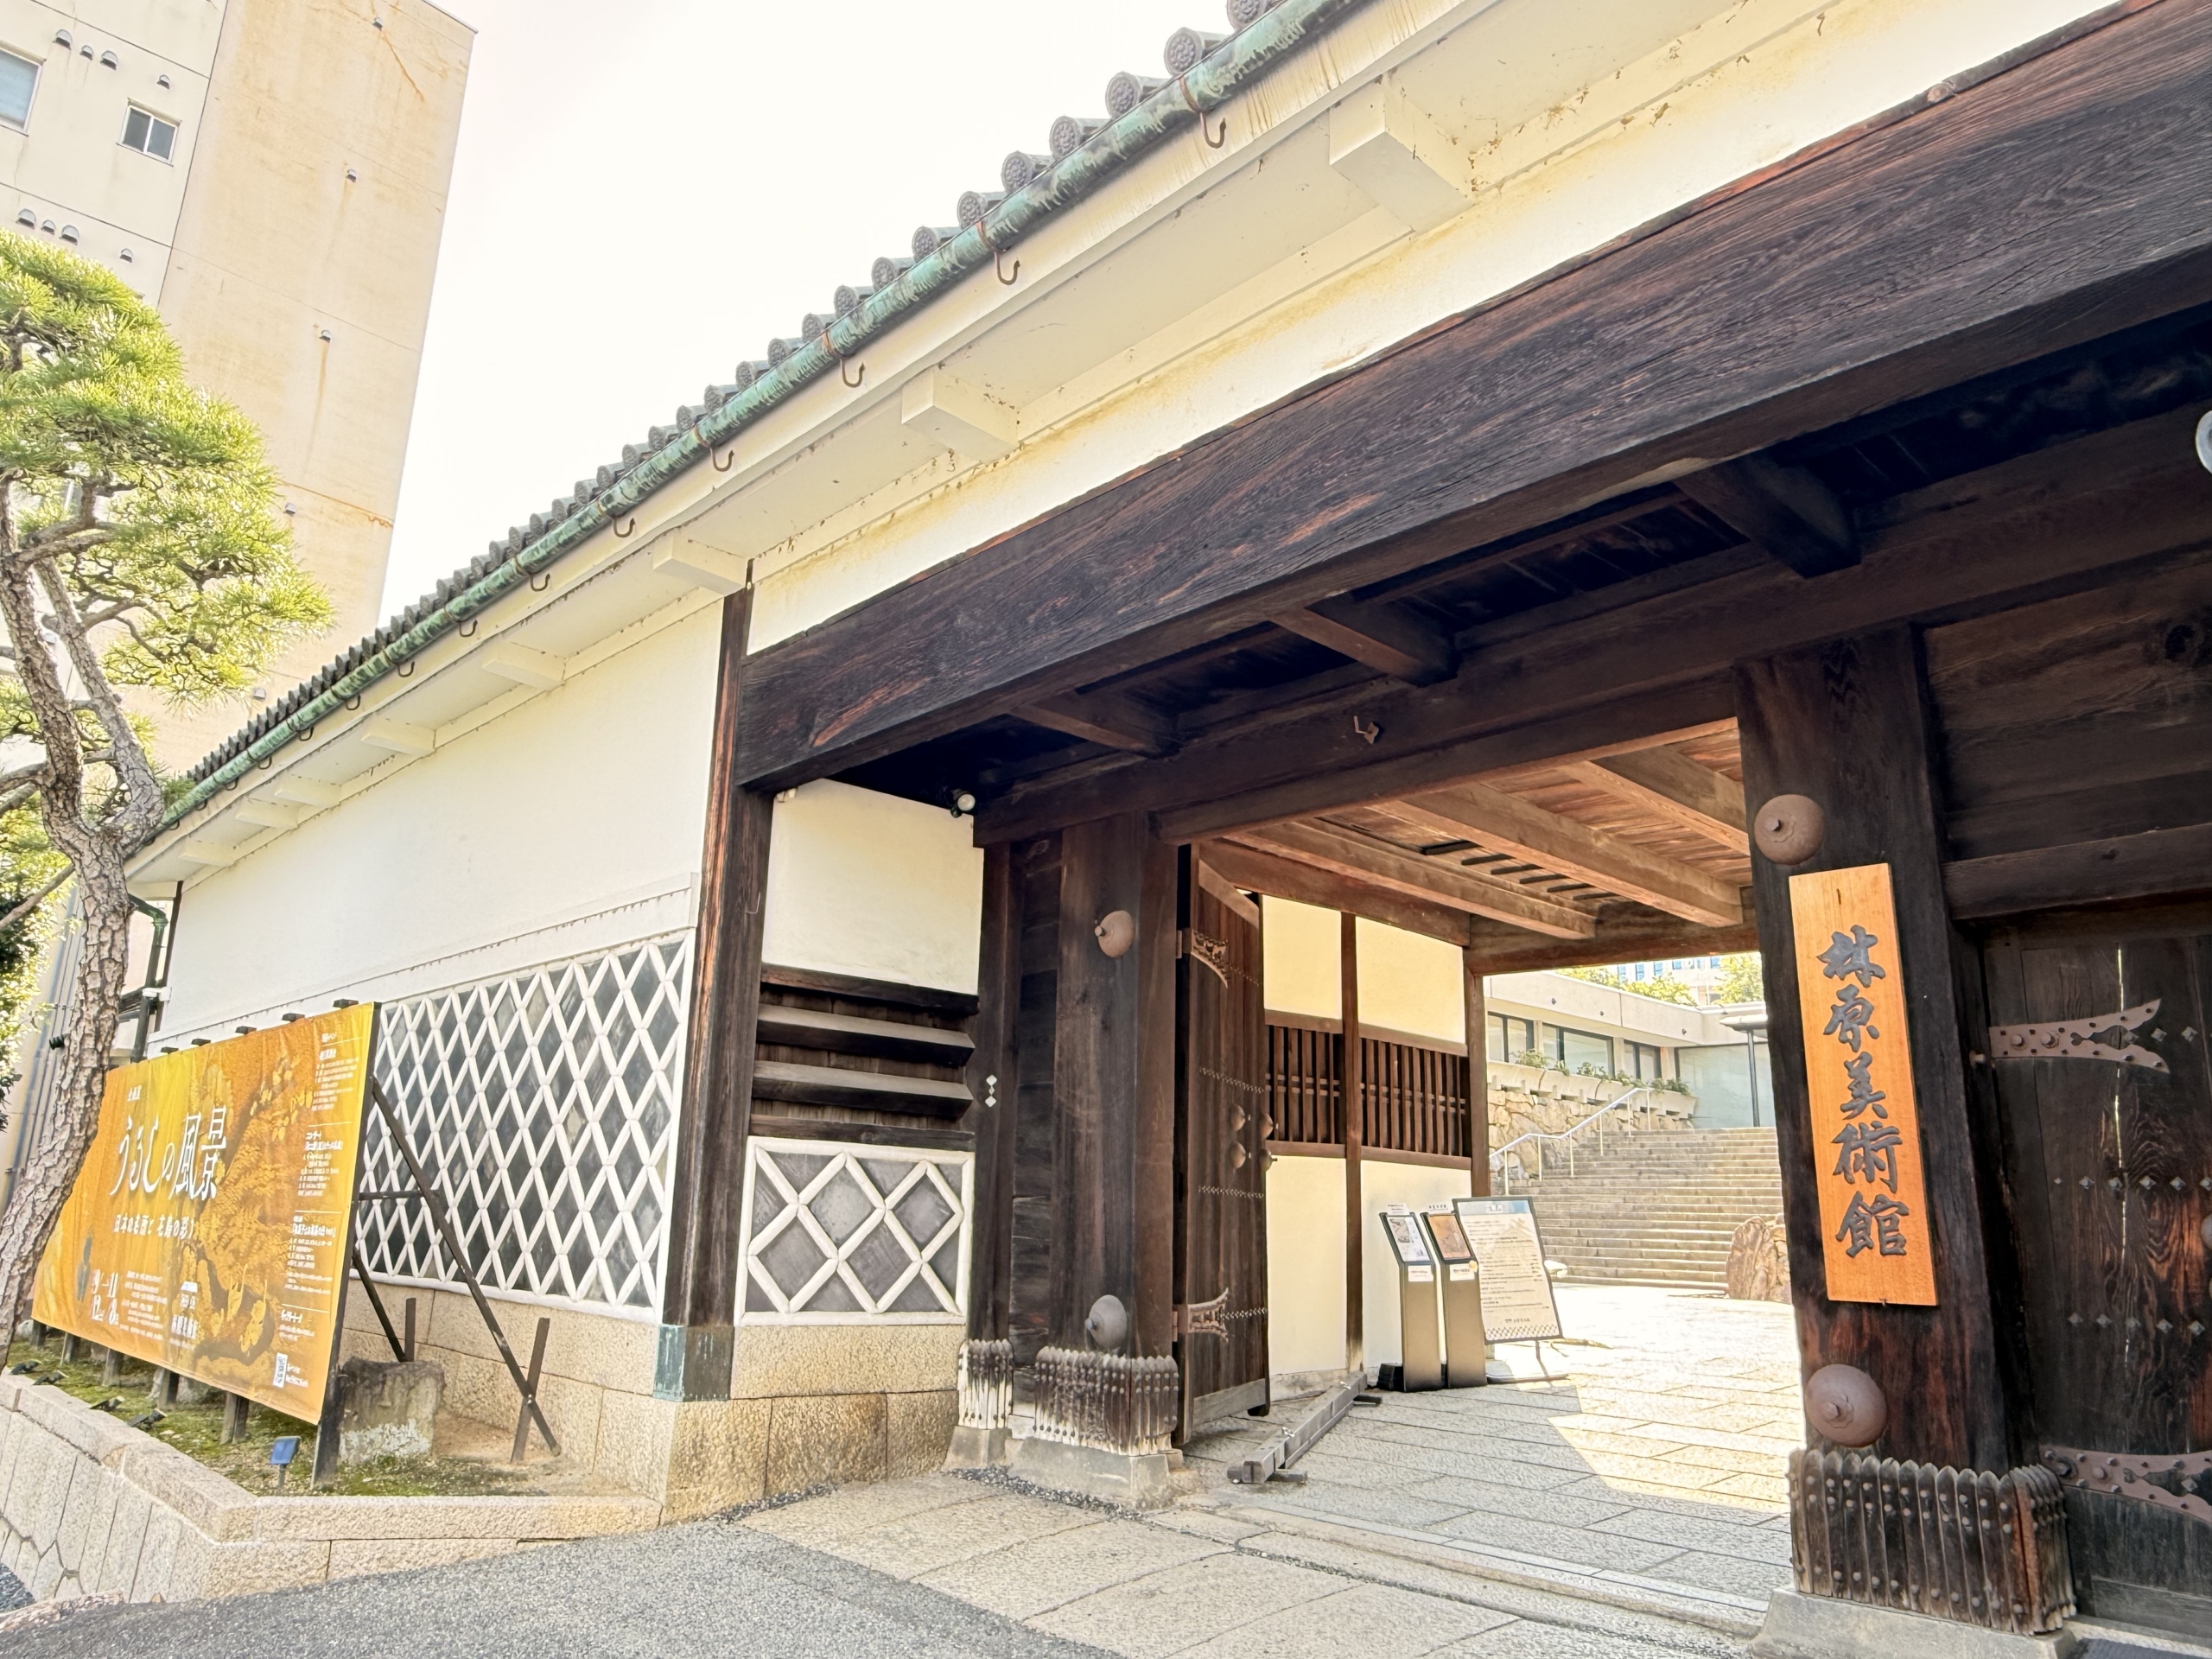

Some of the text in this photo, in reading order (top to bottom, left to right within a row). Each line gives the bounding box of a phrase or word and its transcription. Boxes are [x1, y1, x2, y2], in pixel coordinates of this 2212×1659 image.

[1816, 924, 1909, 1259] 林原美術館
